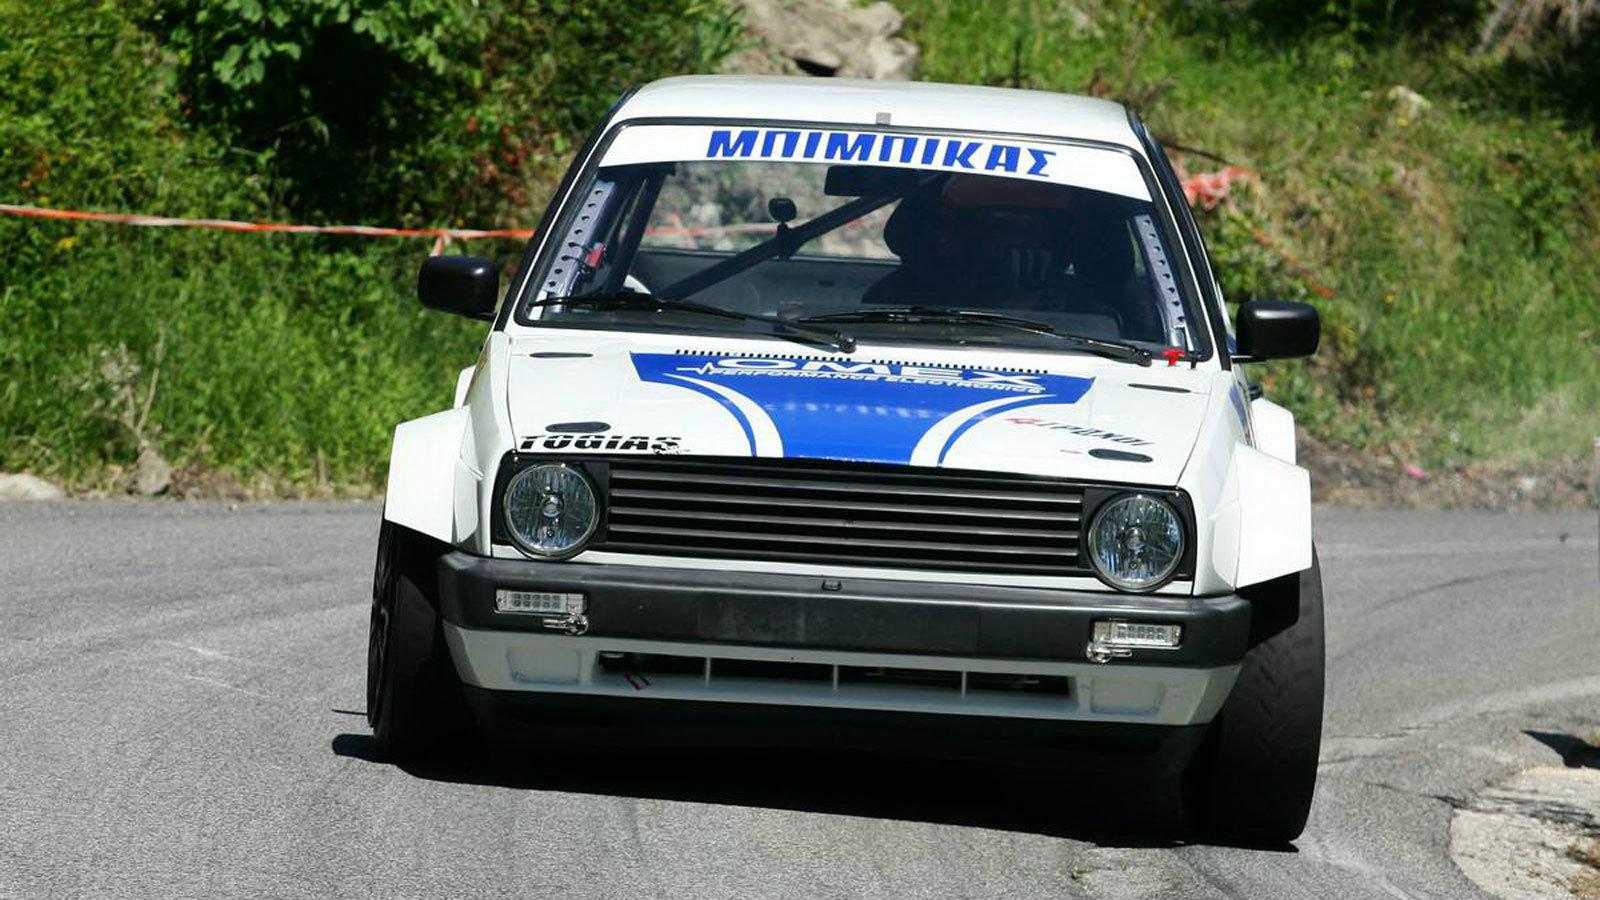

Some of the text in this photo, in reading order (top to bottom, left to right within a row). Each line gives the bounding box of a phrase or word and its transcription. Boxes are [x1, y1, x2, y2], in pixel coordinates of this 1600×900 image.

[706, 130, 1057, 178] ΜΠΙΜΠΙΚΑΣ
[708, 367, 1047, 394] PERFORMANCE ELECTRONICS
[717, 358, 1045, 388] OMEX
[520, 434, 682, 452] TOGIAS
